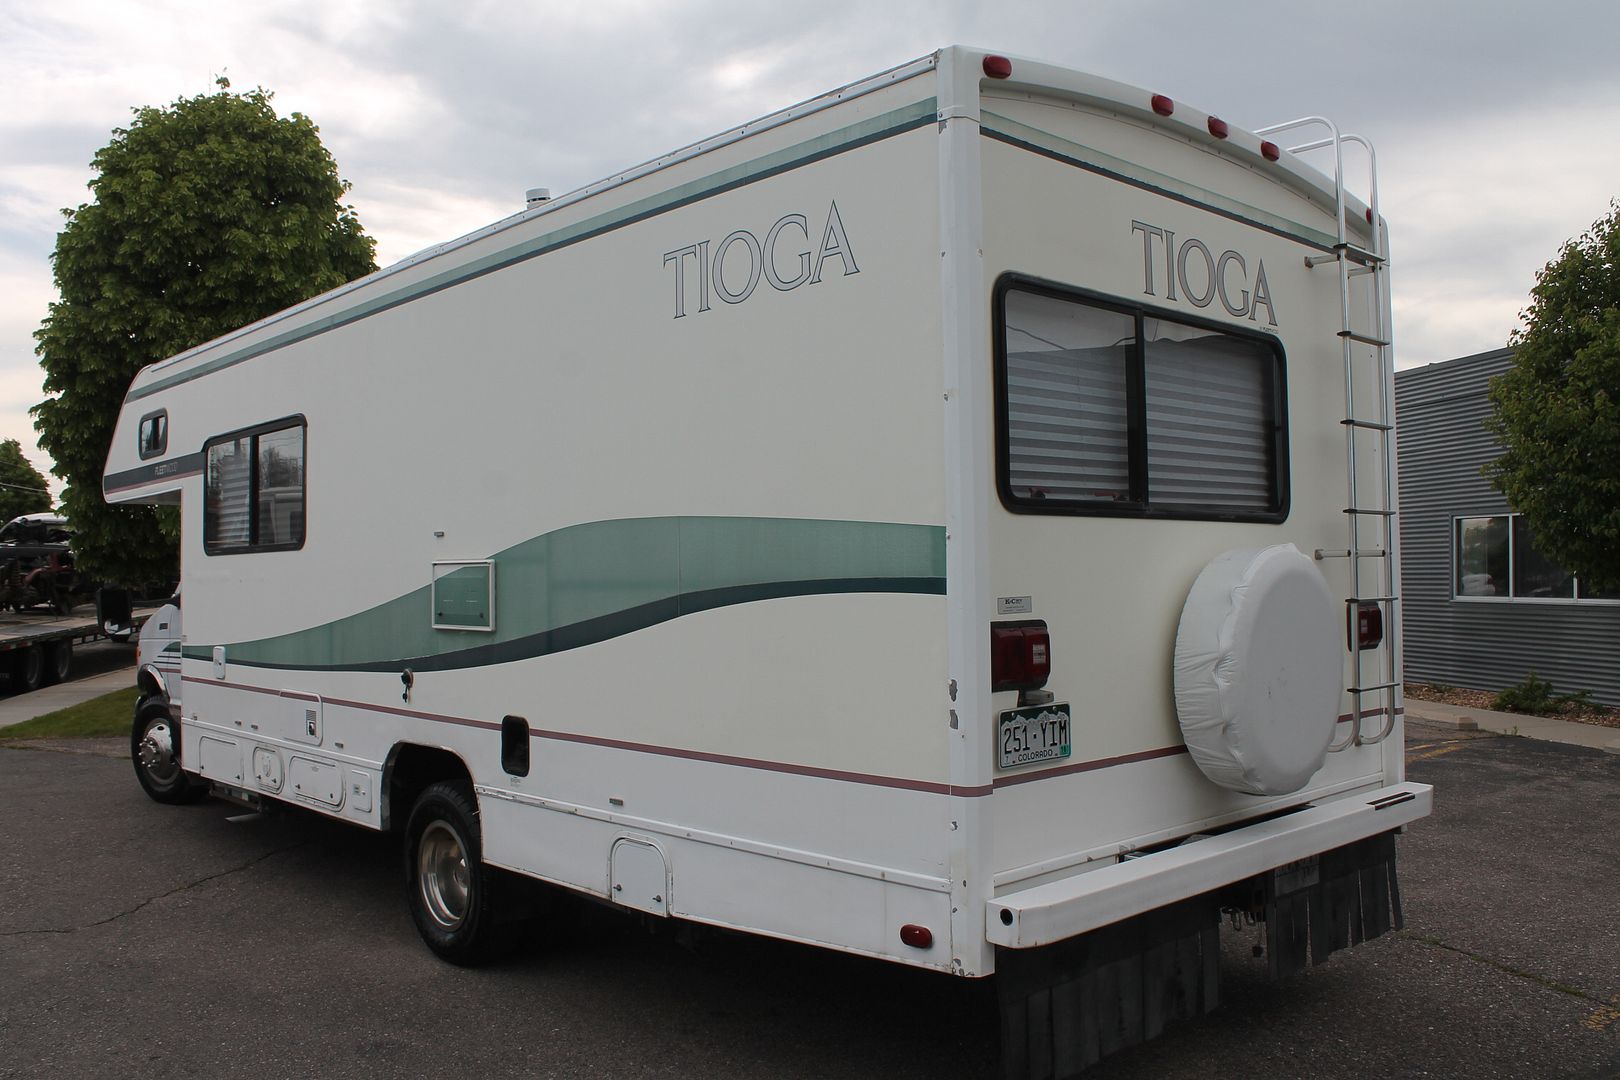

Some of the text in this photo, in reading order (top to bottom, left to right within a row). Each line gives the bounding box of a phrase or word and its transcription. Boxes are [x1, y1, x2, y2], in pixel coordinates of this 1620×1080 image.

[663, 199, 860, 319] TIOGA
[1131, 219, 1278, 326] TIOGA
[1018, 749, 1053, 762] COLORADO
